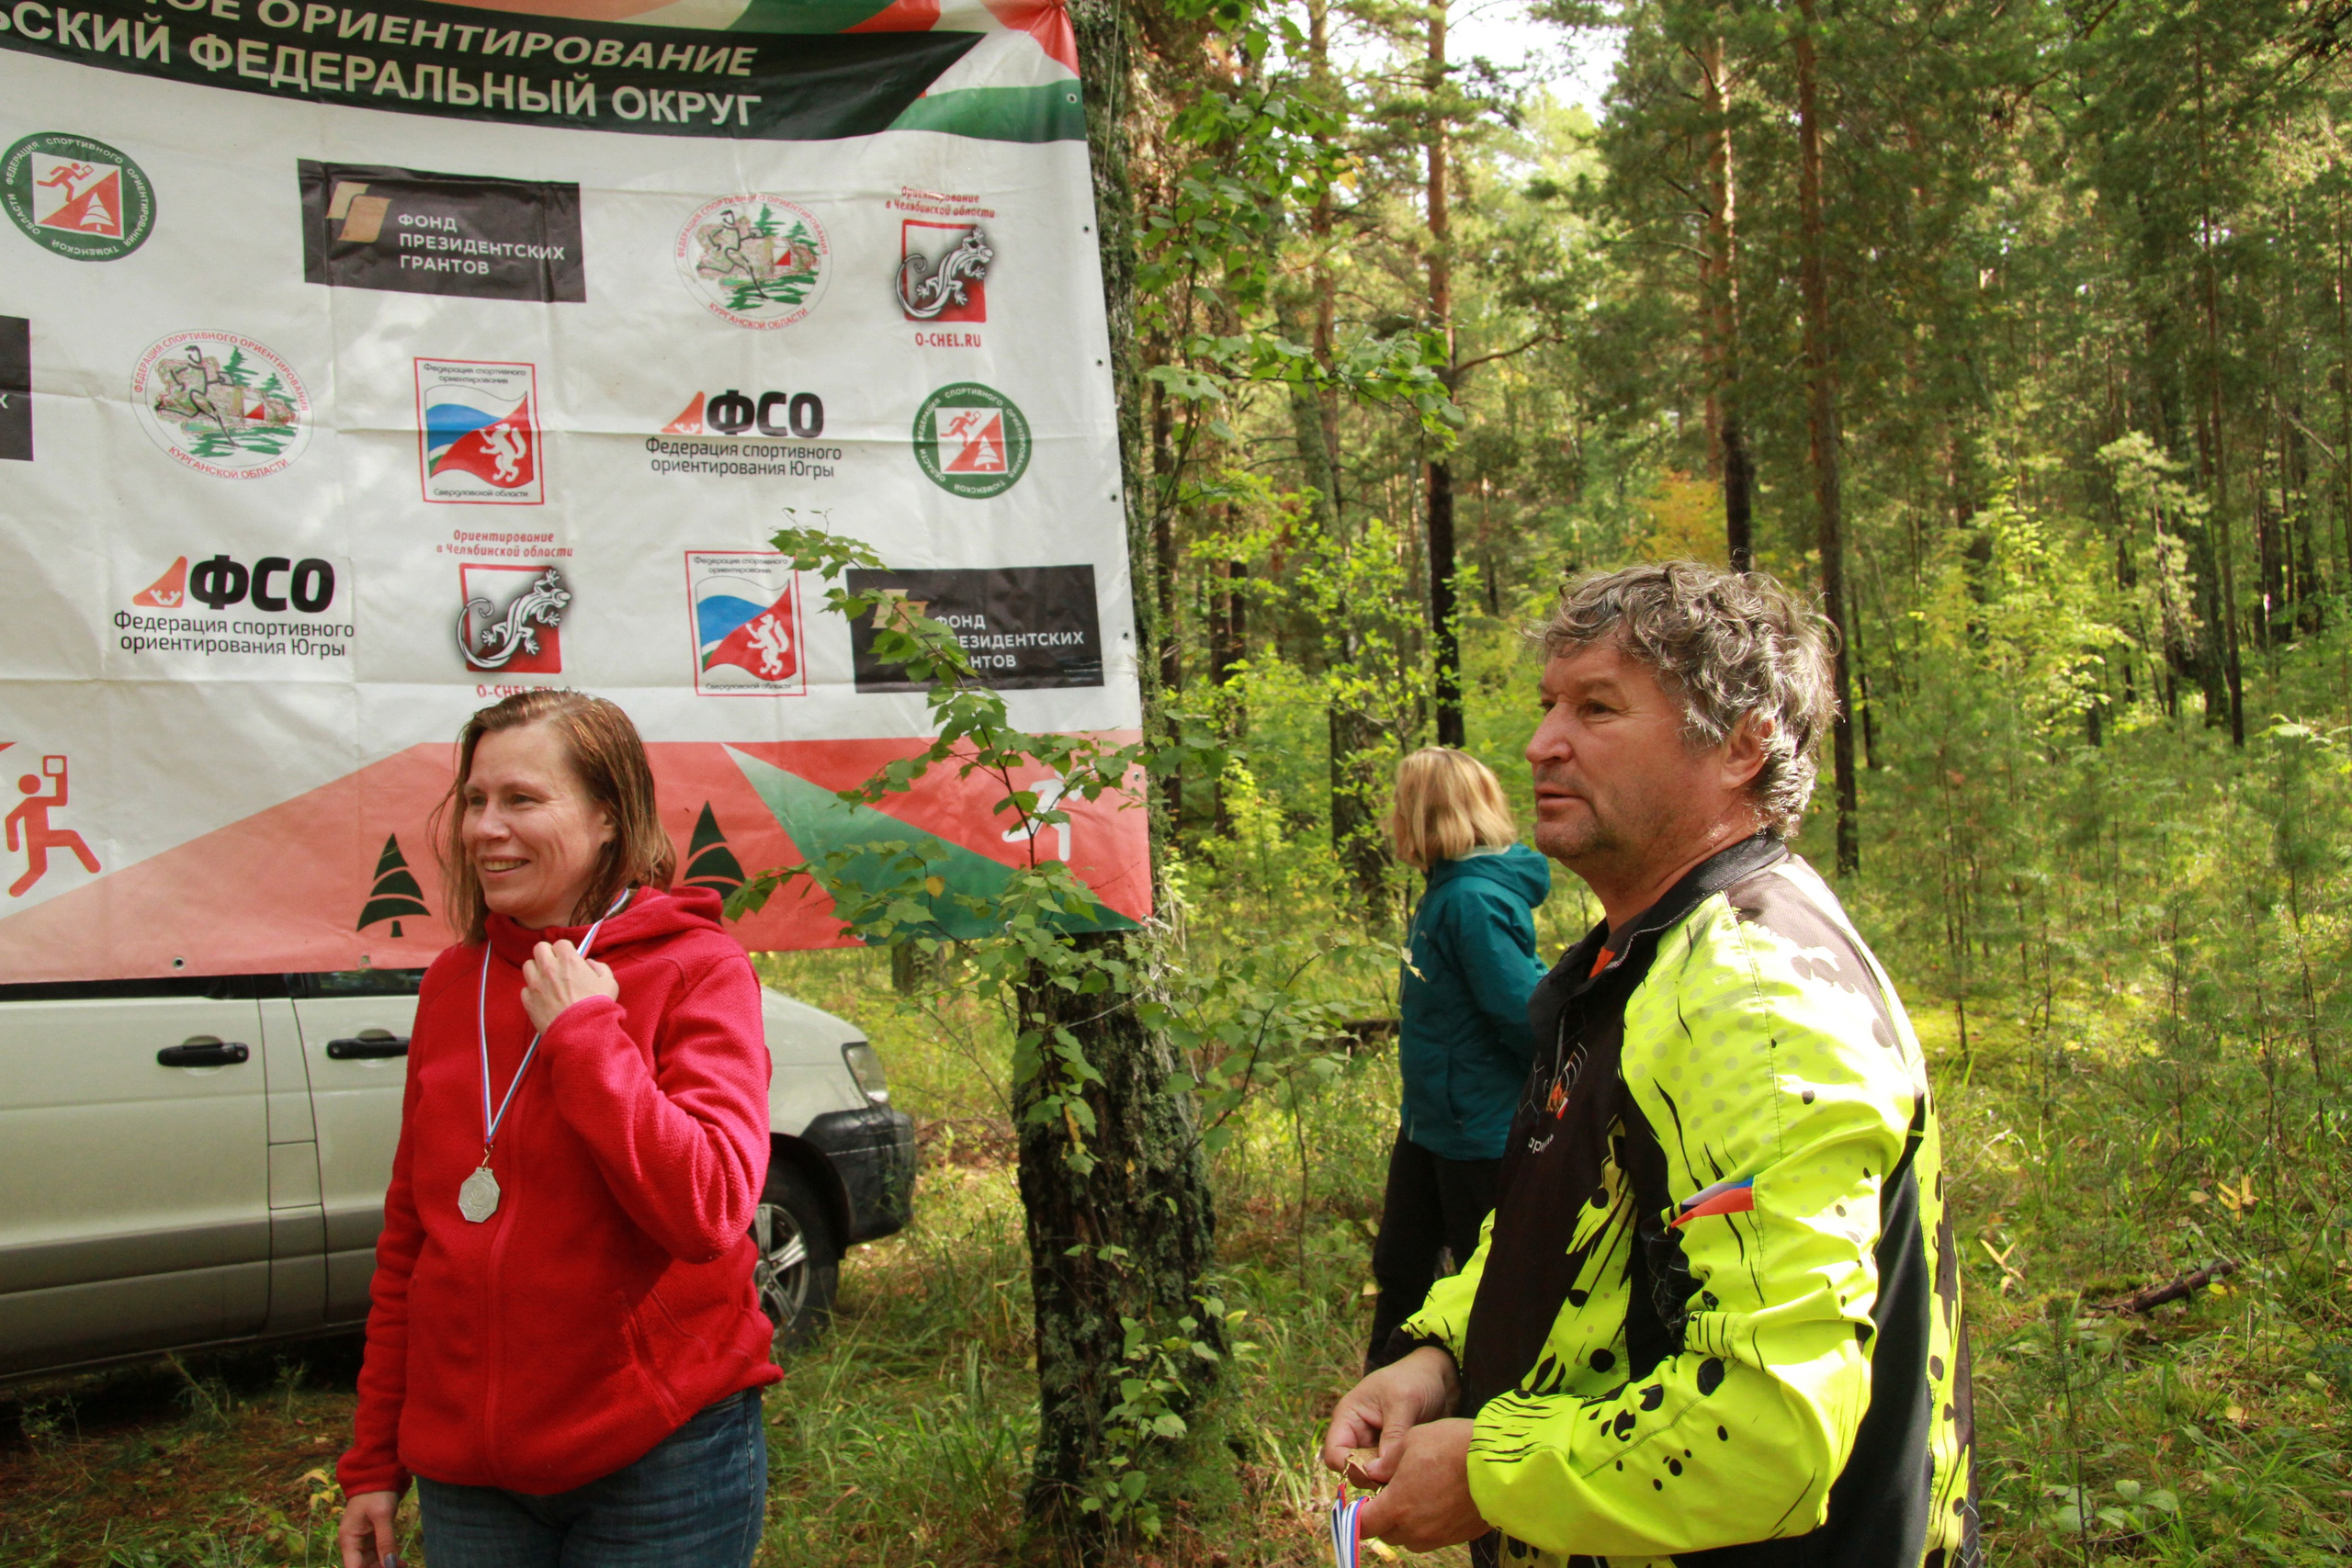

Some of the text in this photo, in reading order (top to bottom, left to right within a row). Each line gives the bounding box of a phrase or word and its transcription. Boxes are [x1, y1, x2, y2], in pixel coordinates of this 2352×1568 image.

[257, 0, 758, 76] ОРИЕНТИРОВАНИЕ
[188, 33, 597, 117] ФЕДЕРАЛЬНЫЙ
[612, 85, 762, 126] ОКРУГ
[6, 138, 150, 255] ФЕДЕРАЦИЯ СПОРТИВНОГО ОРИЕНТИРОВАНИЯ ТЮМЕНСКОЙ ОБЛАСТИ
[886, 198, 995, 218] в Челябинской области
[398, 213, 458, 232] ФОНД
[677, 194, 829, 257] ФЕДЕРАЦИЯ СПОРТИВНОГО ОРИЕНТИРОВАНИЯ
[400, 233, 566, 260] ПРЕЗИДЕНТСКИХ
[400, 255, 490, 275] ГРАНТОВ
[708, 302, 808, 330] КУРГАНСКОЙ ОБЛАСТИ
[915, 333, 981, 347] O-CHEL.RU
[134, 332, 309, 412] ФЕДЕРАЦИЯ СПОРТИВНОГО ОРИЕНТИРОВАНИЯ
[424, 363, 473, 374] Федерация
[944, 388, 1003, 406] СПОРТИВНОГО
[707, 389, 824, 438] ФСО
[918, 398, 941, 441] ФЕДЕРАЦИЯ
[646, 436, 842, 461] Федерация спортивного
[168, 446, 289, 479] КУРГАНСКОЙ ОБЛАСТИ
[651, 459, 834, 480] ориентирования Югры
[919, 448, 946, 482] ОБЛАСТИ
[434, 488, 528, 498] Свердловской области
[453, 529, 554, 545] Ориентирование
[436, 543, 573, 558] в Челябинской области
[189, 554, 334, 614] ФСО
[114, 610, 355, 639] Федерация спортивного
[120, 635, 345, 660] ориентирования Югры
[949, 631, 1084, 649] ЕЗИДЕНТСКИХ
